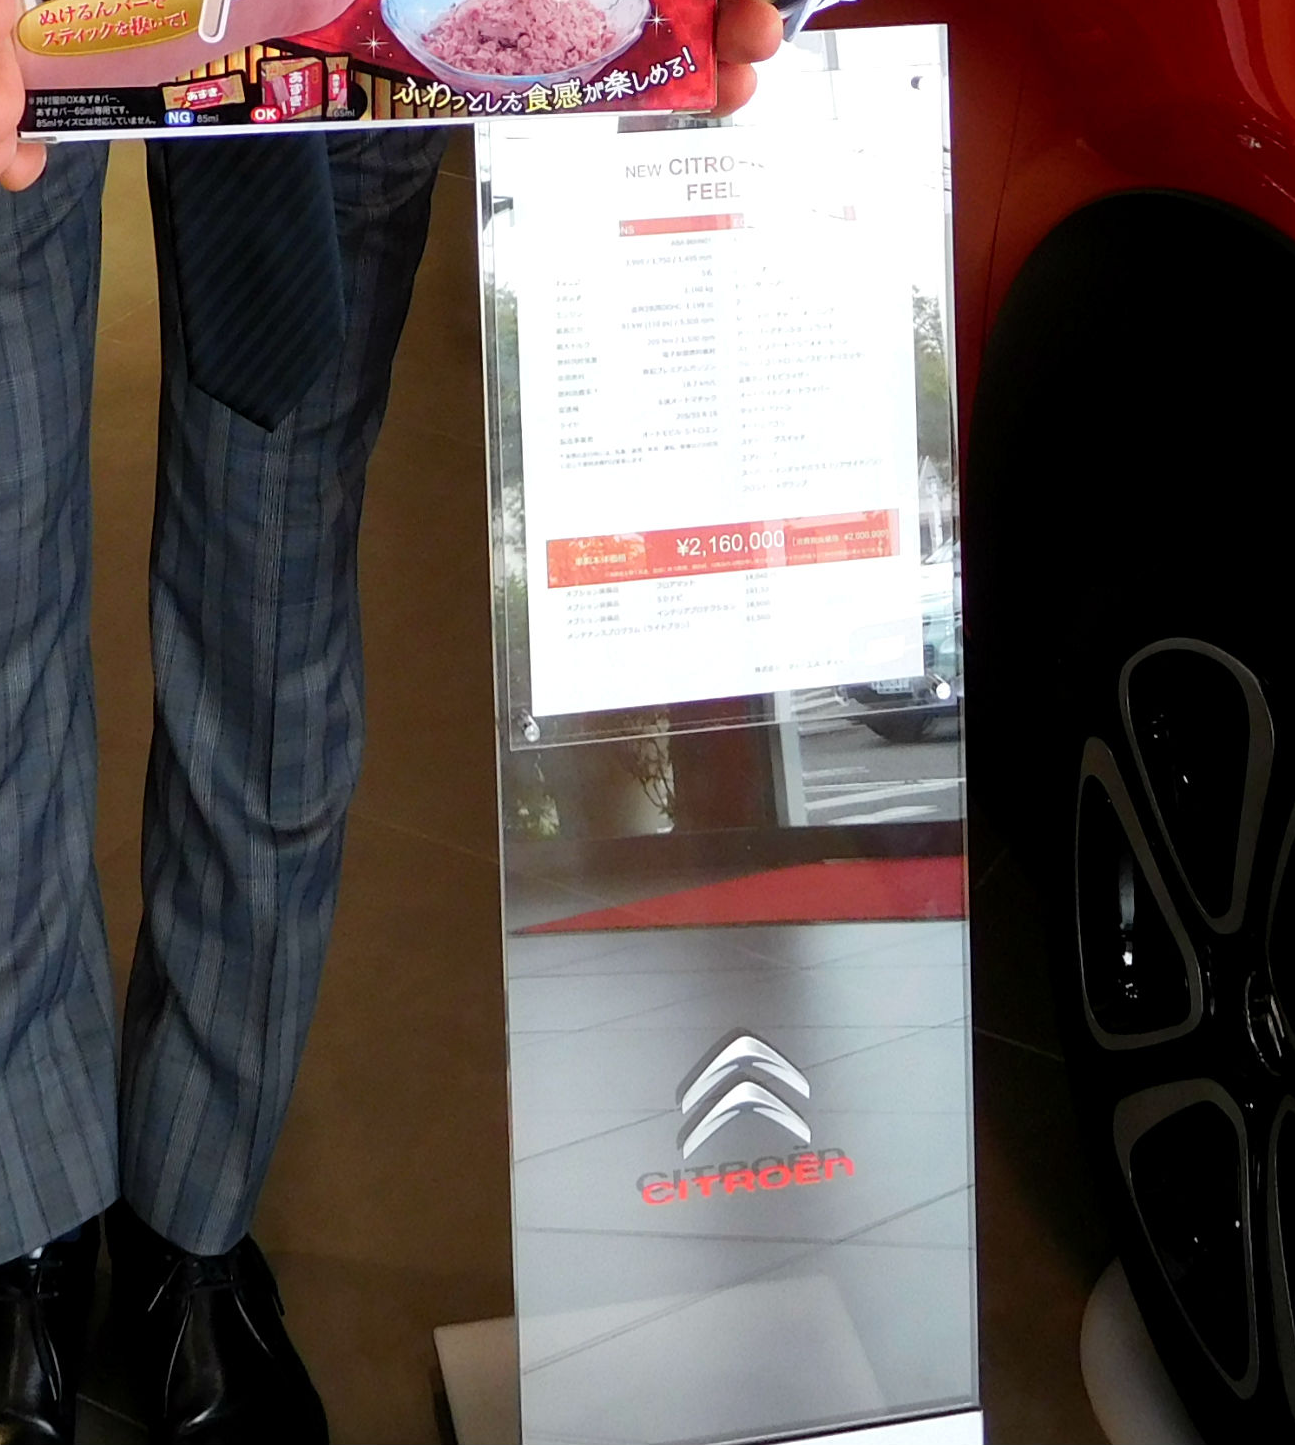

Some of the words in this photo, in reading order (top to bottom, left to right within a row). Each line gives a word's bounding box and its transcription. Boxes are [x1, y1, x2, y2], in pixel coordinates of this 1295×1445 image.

[168, 111, 191, 124] NG
[196, 114, 219, 124] 85ml
[254, 108, 278, 121] OK
[625, 164, 662, 178] NEW
[668, 155, 764, 176] CITRO
[686, 181, 741, 201] FEEL
[675, 529, 785, 558] ¥2,160,000
[641, 1152, 855, 1206] CITROËN
